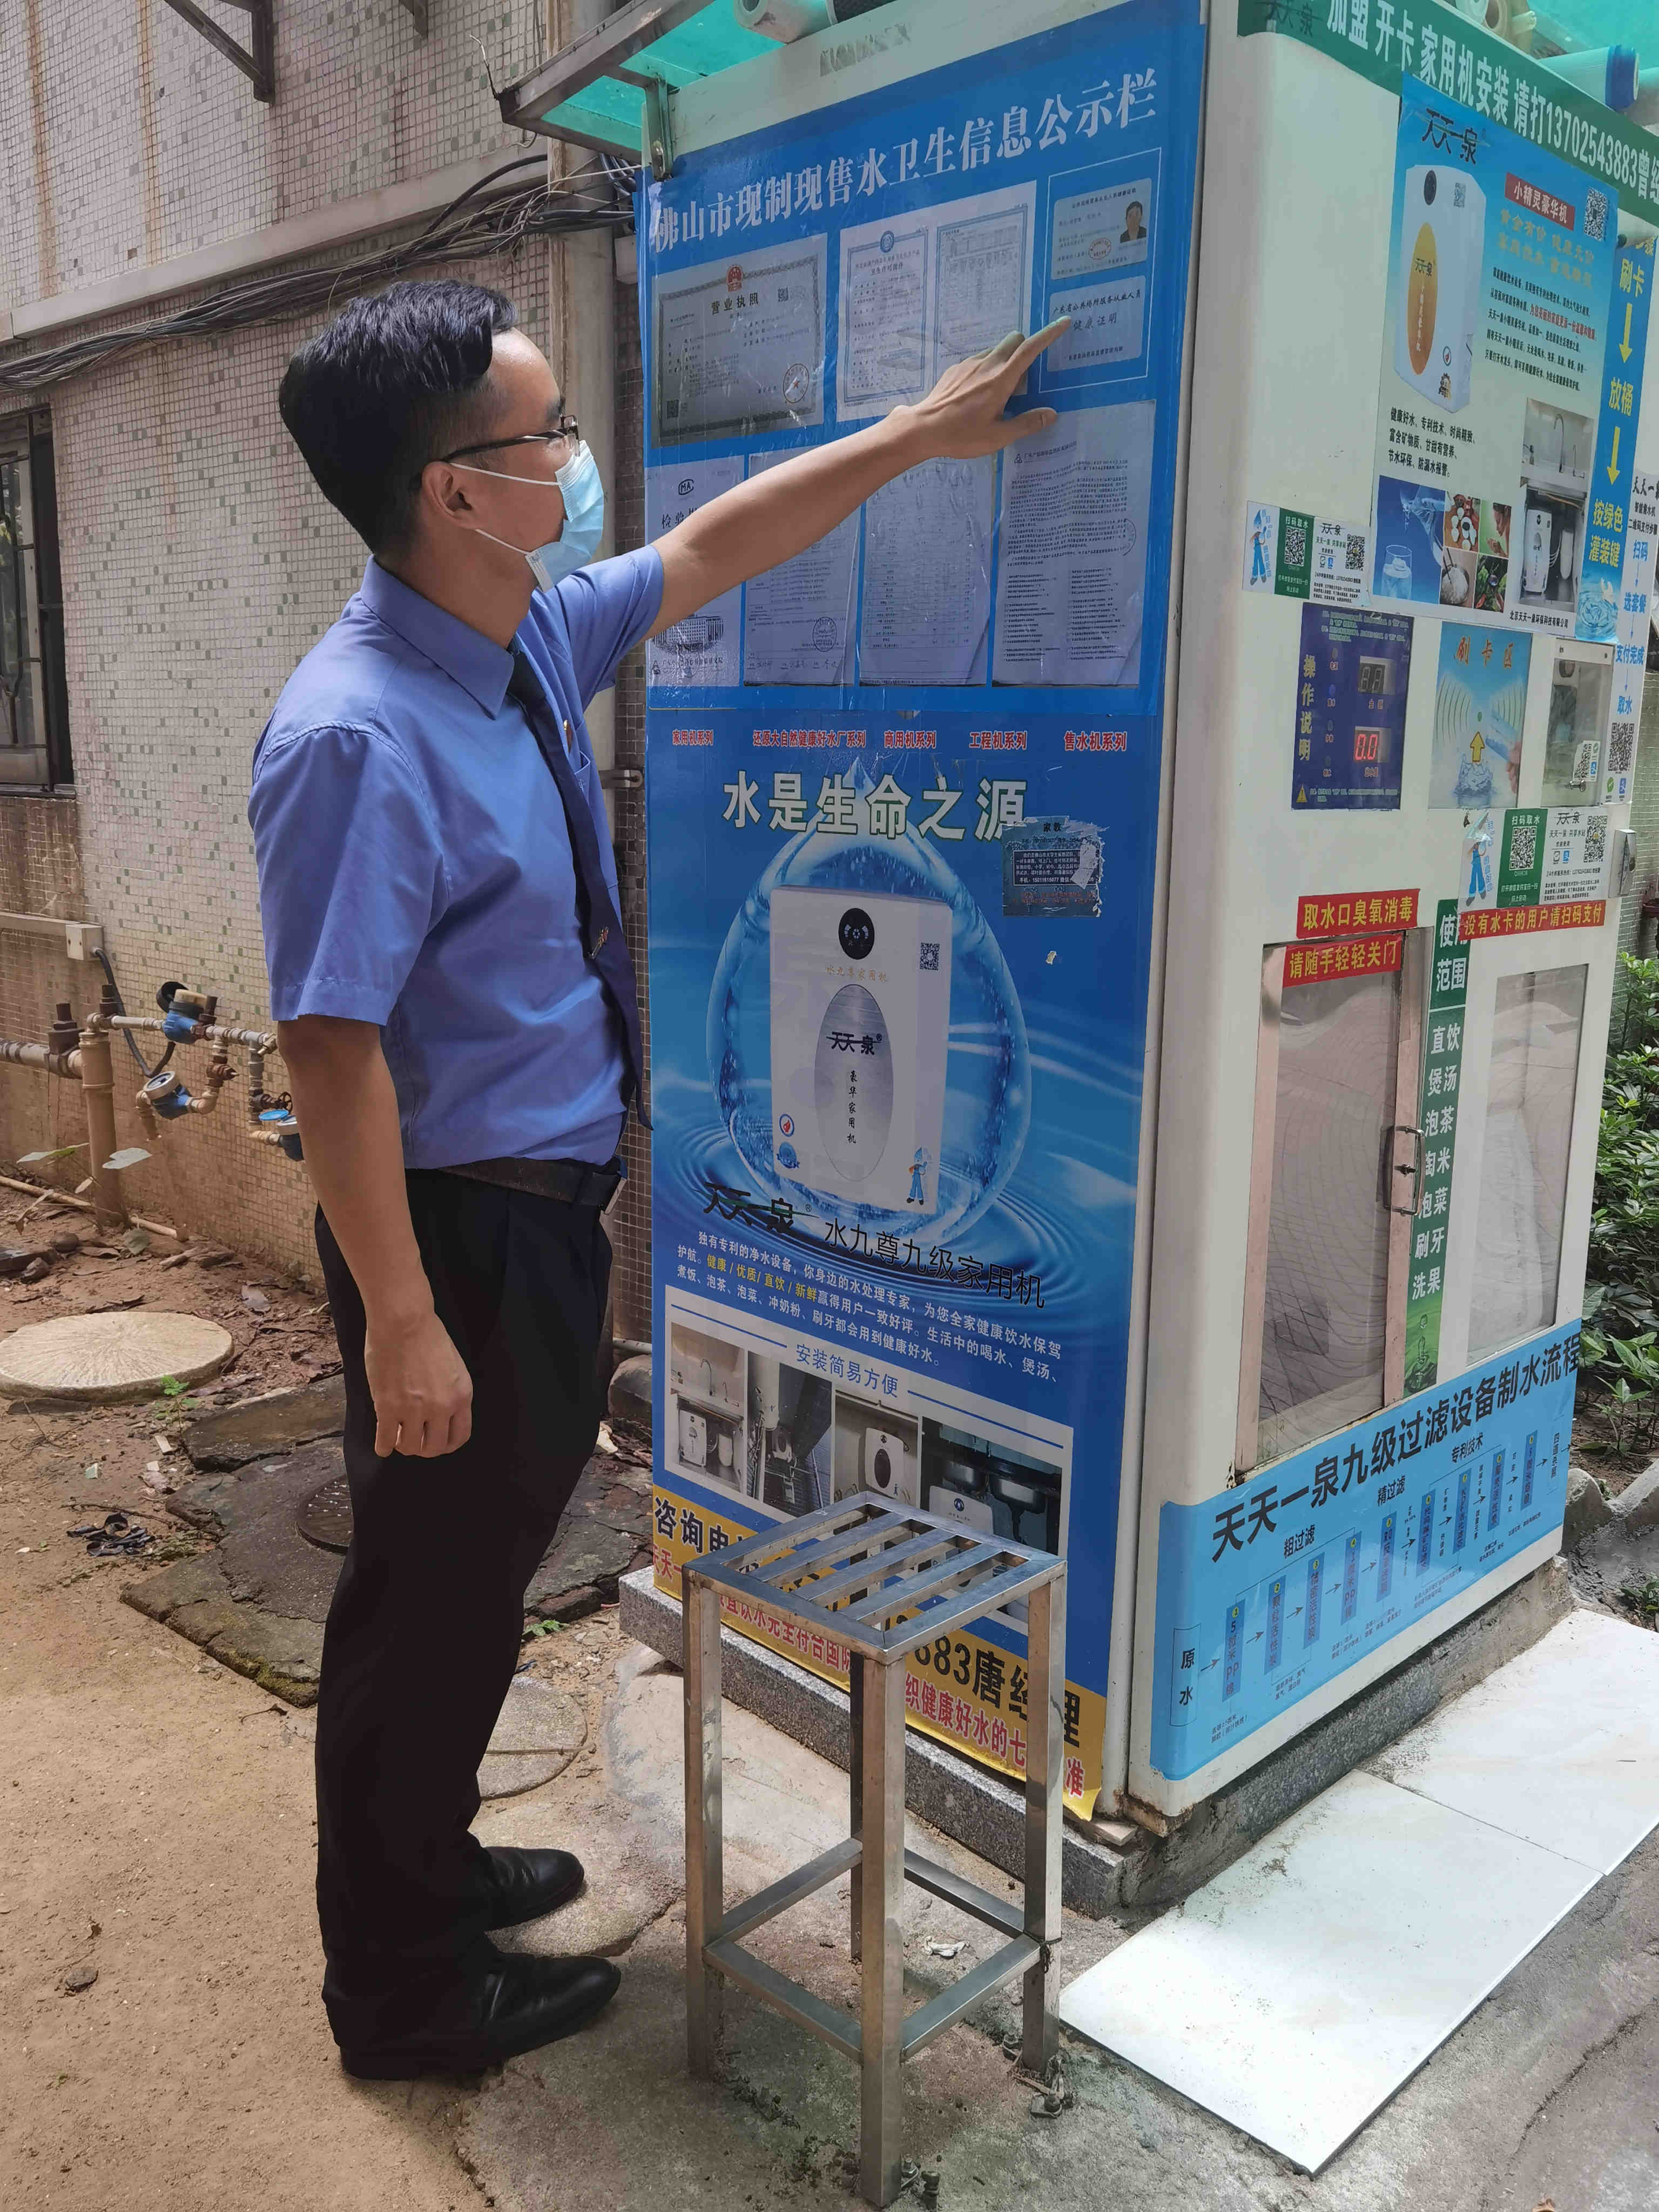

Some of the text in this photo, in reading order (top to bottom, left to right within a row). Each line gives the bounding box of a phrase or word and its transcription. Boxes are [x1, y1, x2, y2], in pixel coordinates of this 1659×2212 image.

[654, 68, 1156, 253] 佛山市现制现售水卫生信息公示栏
[1514, 181, 1567, 224] 小精灵豪华机
[1620, 258, 1645, 298] 刷卡
[711, 292, 759, 315] 营业执照
[1073, 312, 1118, 331] 健康证明
[1608, 377, 1634, 417] 放桶
[1593, 498, 1623, 534] 按绿色
[1633, 539, 1648, 562] 扫码
[1615, 644, 1644, 665] 支付完成
[1298, 654, 1316, 761] 操作说明
[1617, 695, 1633, 715] 取水
[672, 730, 714, 746] 家用机系列
[753, 730, 866, 748] 还原大自然健康好水厂系列
[884, 730, 936, 749] 商用机系列
[969, 731, 1027, 750] 工程机系列
[1064, 731, 1128, 751] 售水机系列
[722, 770, 1027, 841] 水是生命之源
[1043, 822, 1062, 832] 家教
[1303, 895, 1414, 930] 取水口臭氧消毒
[1464, 903, 1602, 936] 没有水卡的用户请扫码支付
[1289, 940, 1398, 980] 请随手轻轻关门
[1435, 956, 1467, 993] 范围
[1431, 1022, 1460, 1055] 直饮
[1427, 1065, 1458, 1098] 煲汤
[847, 1070, 858, 1144] 豪华家用机
[1424, 1105, 1455, 1137] 泡茶
[1415, 1226, 1445, 1260] 刷牙
[825, 1217, 1045, 1310] 水九尊九级家用机
[1412, 1266, 1441, 1300] 洗果
[796, 1344, 899, 1399] 安装简易方便
[1211, 1331, 1581, 1563] 天天一泉九级过滤设备制水流程
[1452, 1432, 1483, 1463] 专利技术
[1377, 1475, 1405, 1507] 精过滤
[654, 1496, 748, 1553] 咨询电
[1283, 1524, 1316, 1559] 粗过滤
